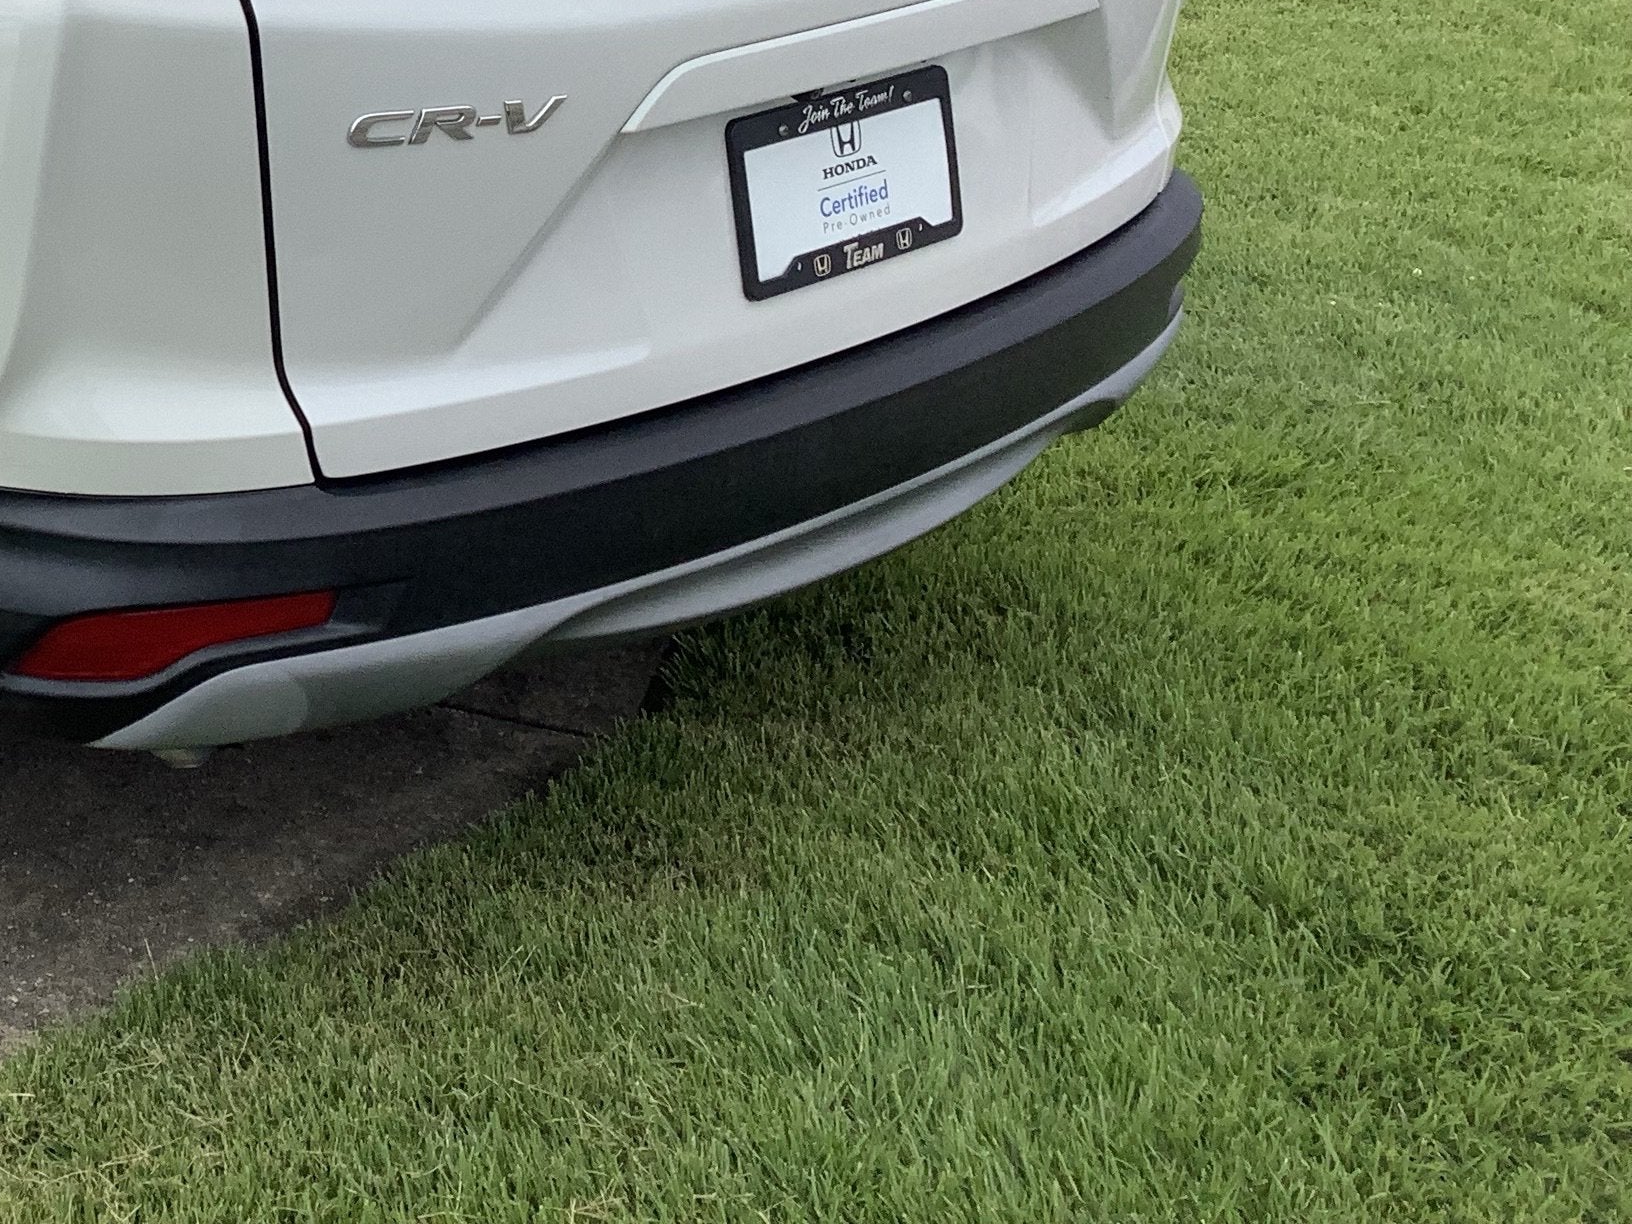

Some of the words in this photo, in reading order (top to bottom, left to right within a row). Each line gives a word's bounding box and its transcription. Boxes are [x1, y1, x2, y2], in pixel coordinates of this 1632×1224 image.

[346, 94, 568, 148] CR-V
[798, 104, 830, 133] Join
[830, 96, 855, 118] The
[855, 85, 894, 112] Team!
[822, 155, 878, 180] HONDA
[820, 179, 889, 218] Certified
[843, 241, 885, 270] TEAM
